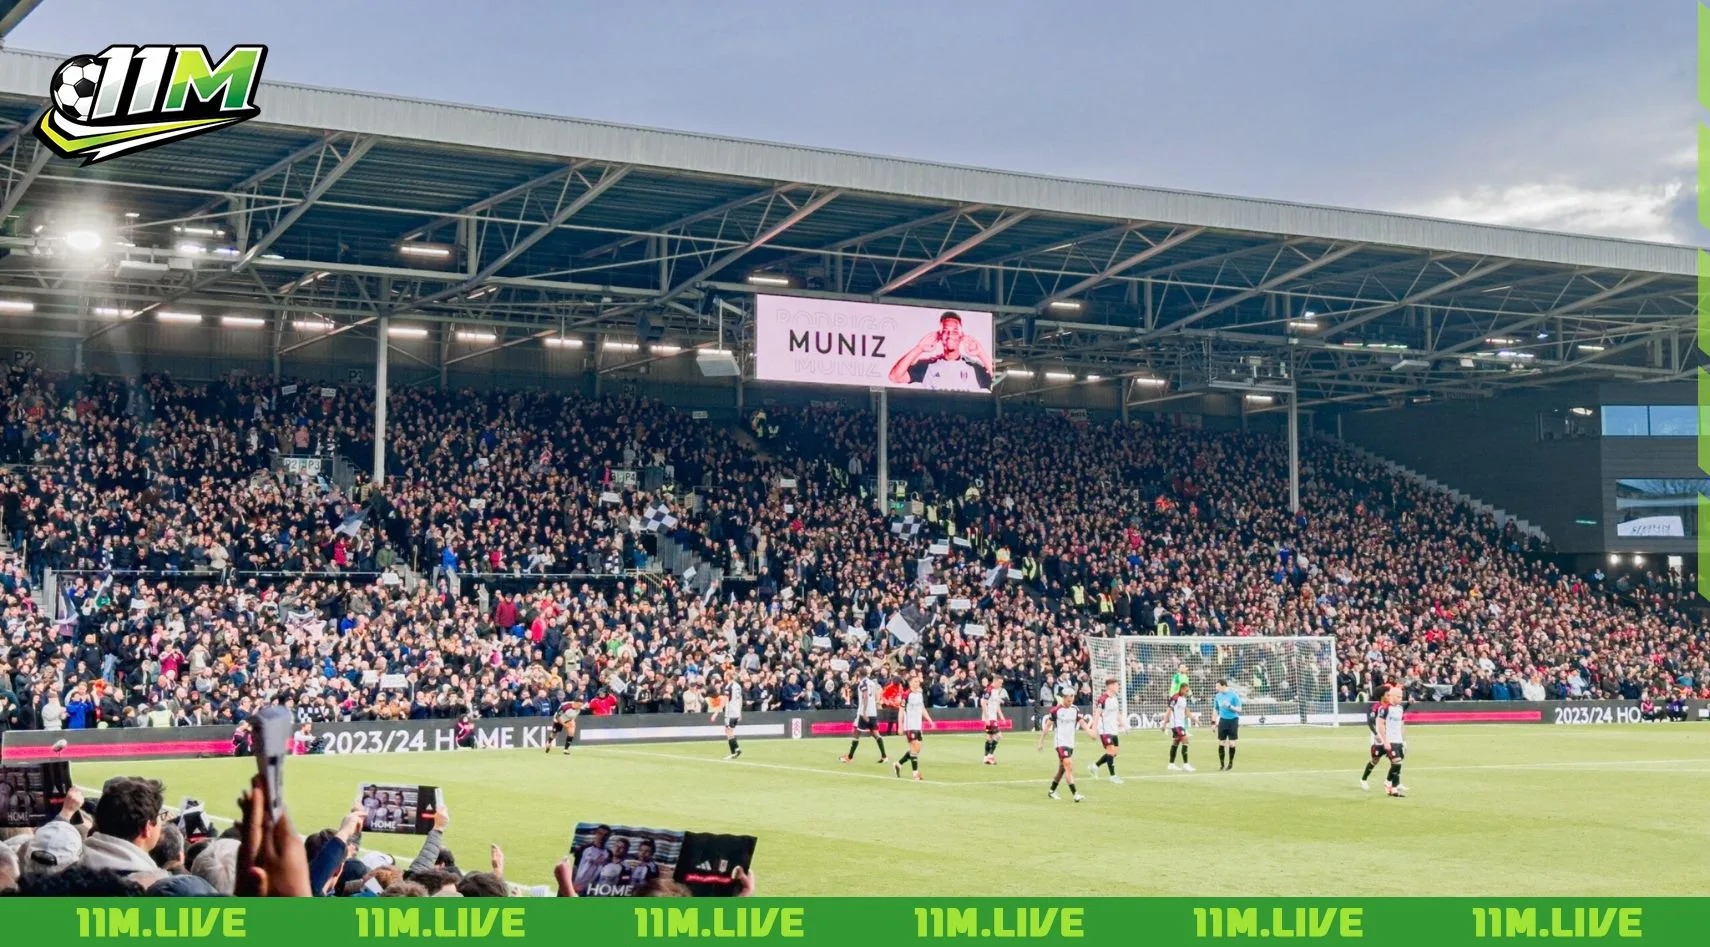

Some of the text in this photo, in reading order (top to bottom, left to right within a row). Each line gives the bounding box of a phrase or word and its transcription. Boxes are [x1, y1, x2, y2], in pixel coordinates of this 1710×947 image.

[789, 329, 886, 358] MUNIZ
[308, 460, 320, 470] P3
[1555, 706, 1613, 724] 2023/24
[323, 729, 427, 754] 2023/24
[435, 727, 514, 751] HME
[370, 820, 396, 828] HOME
[587, 883, 634, 897] HOME
